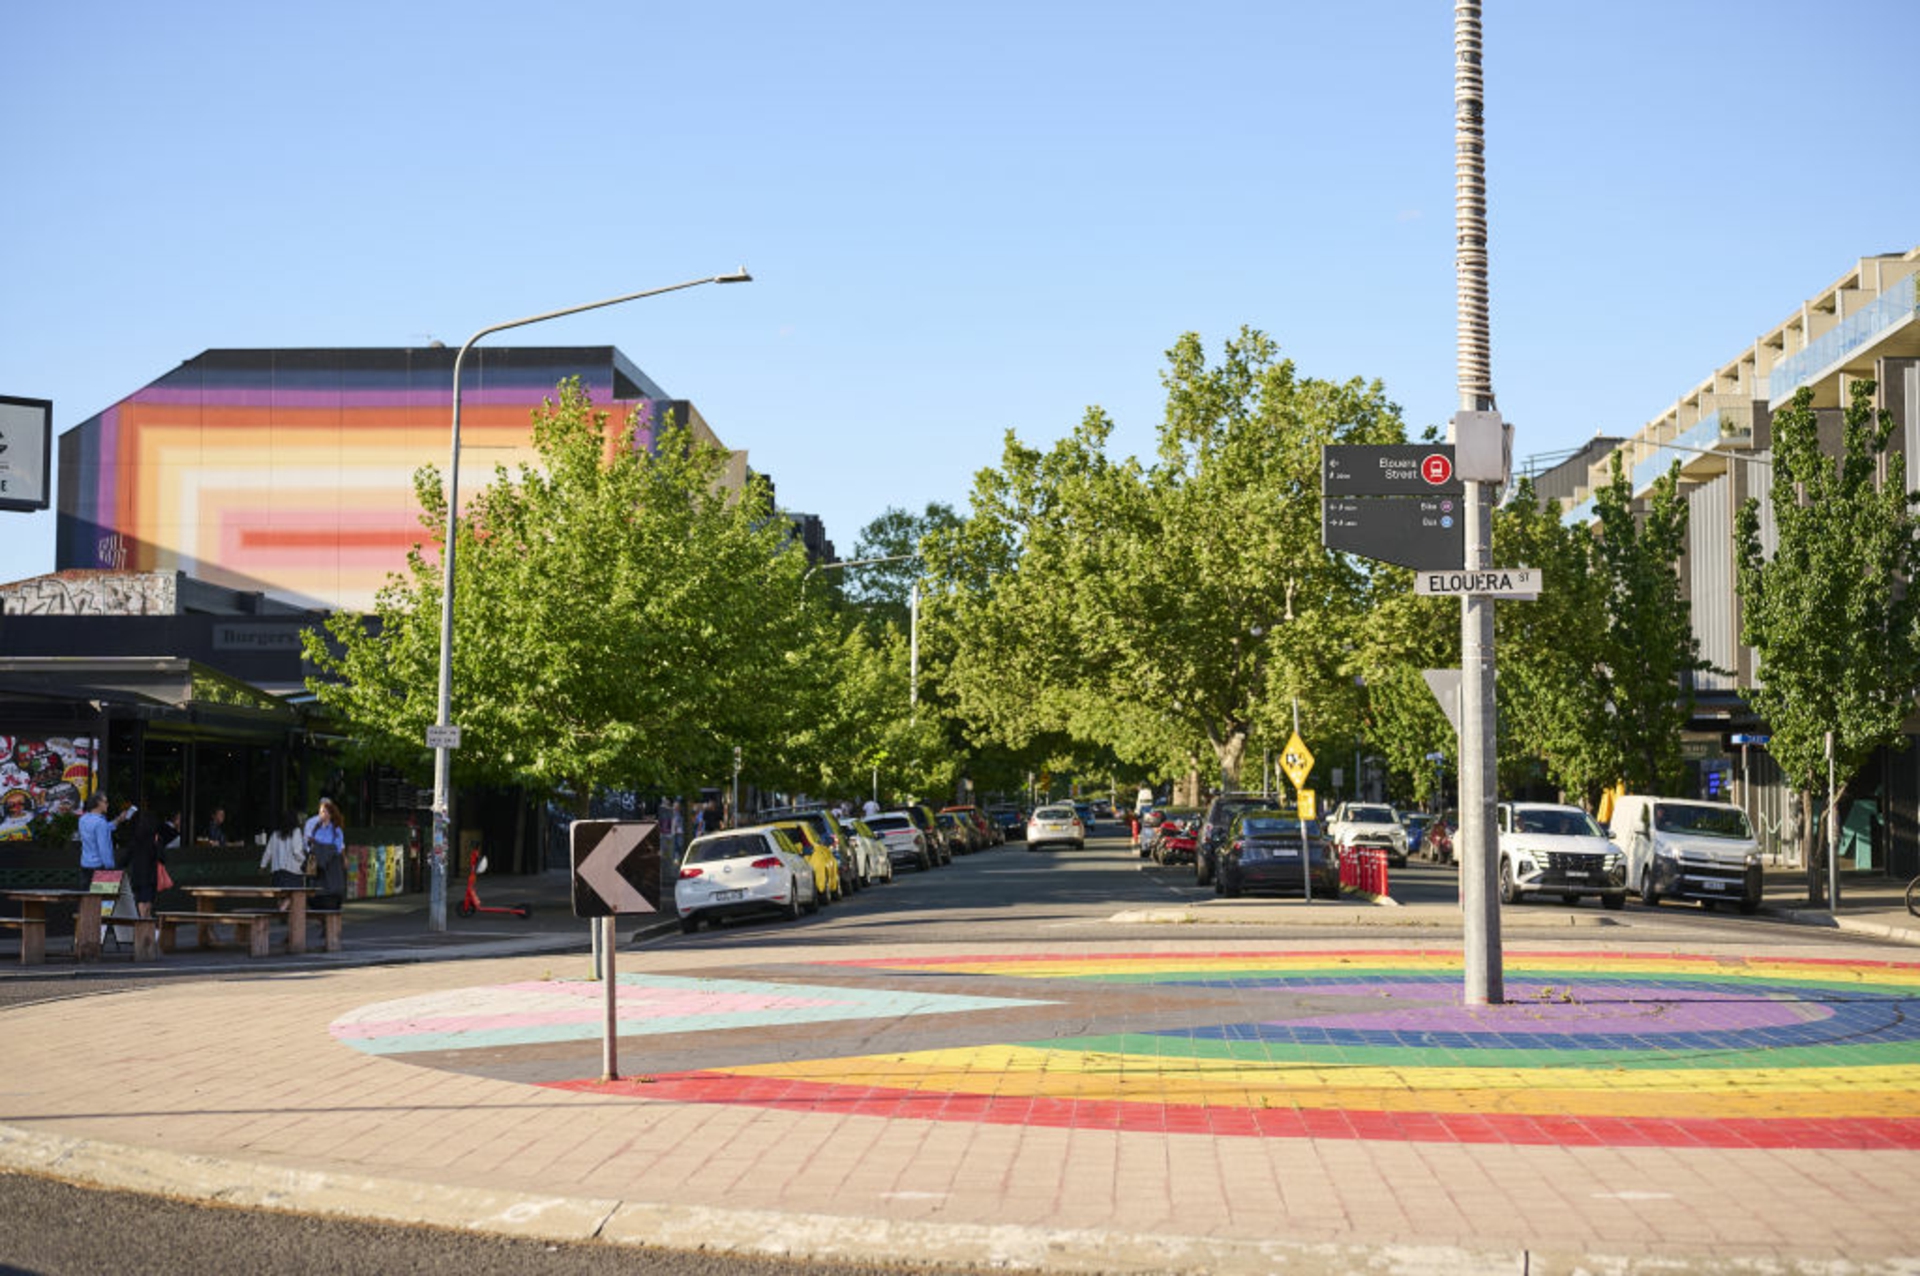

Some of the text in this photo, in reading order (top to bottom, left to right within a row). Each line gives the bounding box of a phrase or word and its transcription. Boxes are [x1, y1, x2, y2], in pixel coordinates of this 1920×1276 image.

[1385, 469, 1418, 479] Street
[1429, 572, 1530, 592] ELOUERA ST
[223, 630, 295, 647] Burgers
